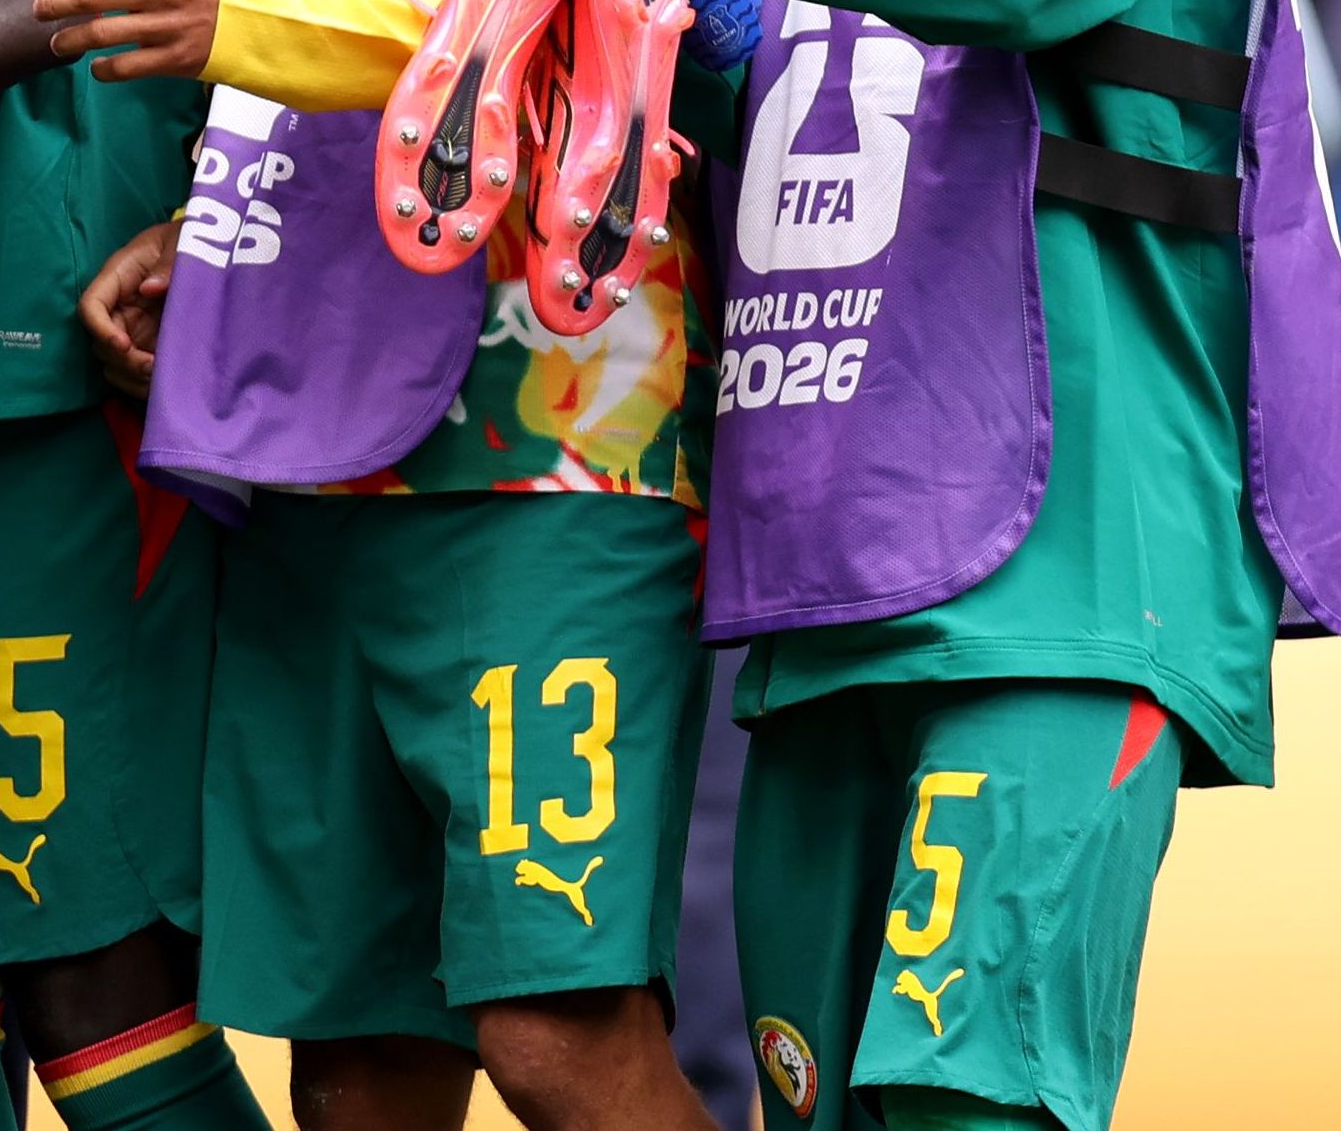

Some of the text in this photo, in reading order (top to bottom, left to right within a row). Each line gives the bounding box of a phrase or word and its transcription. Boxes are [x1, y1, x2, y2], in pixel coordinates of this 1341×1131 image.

[176, 196, 283, 268] 26
[775, 179, 855, 228] FIFA
[724, 288, 884, 339] WORLD CUP
[716, 338, 869, 417] 2026
[471, 658, 617, 856] 13
[885, 772, 988, 957] 5
